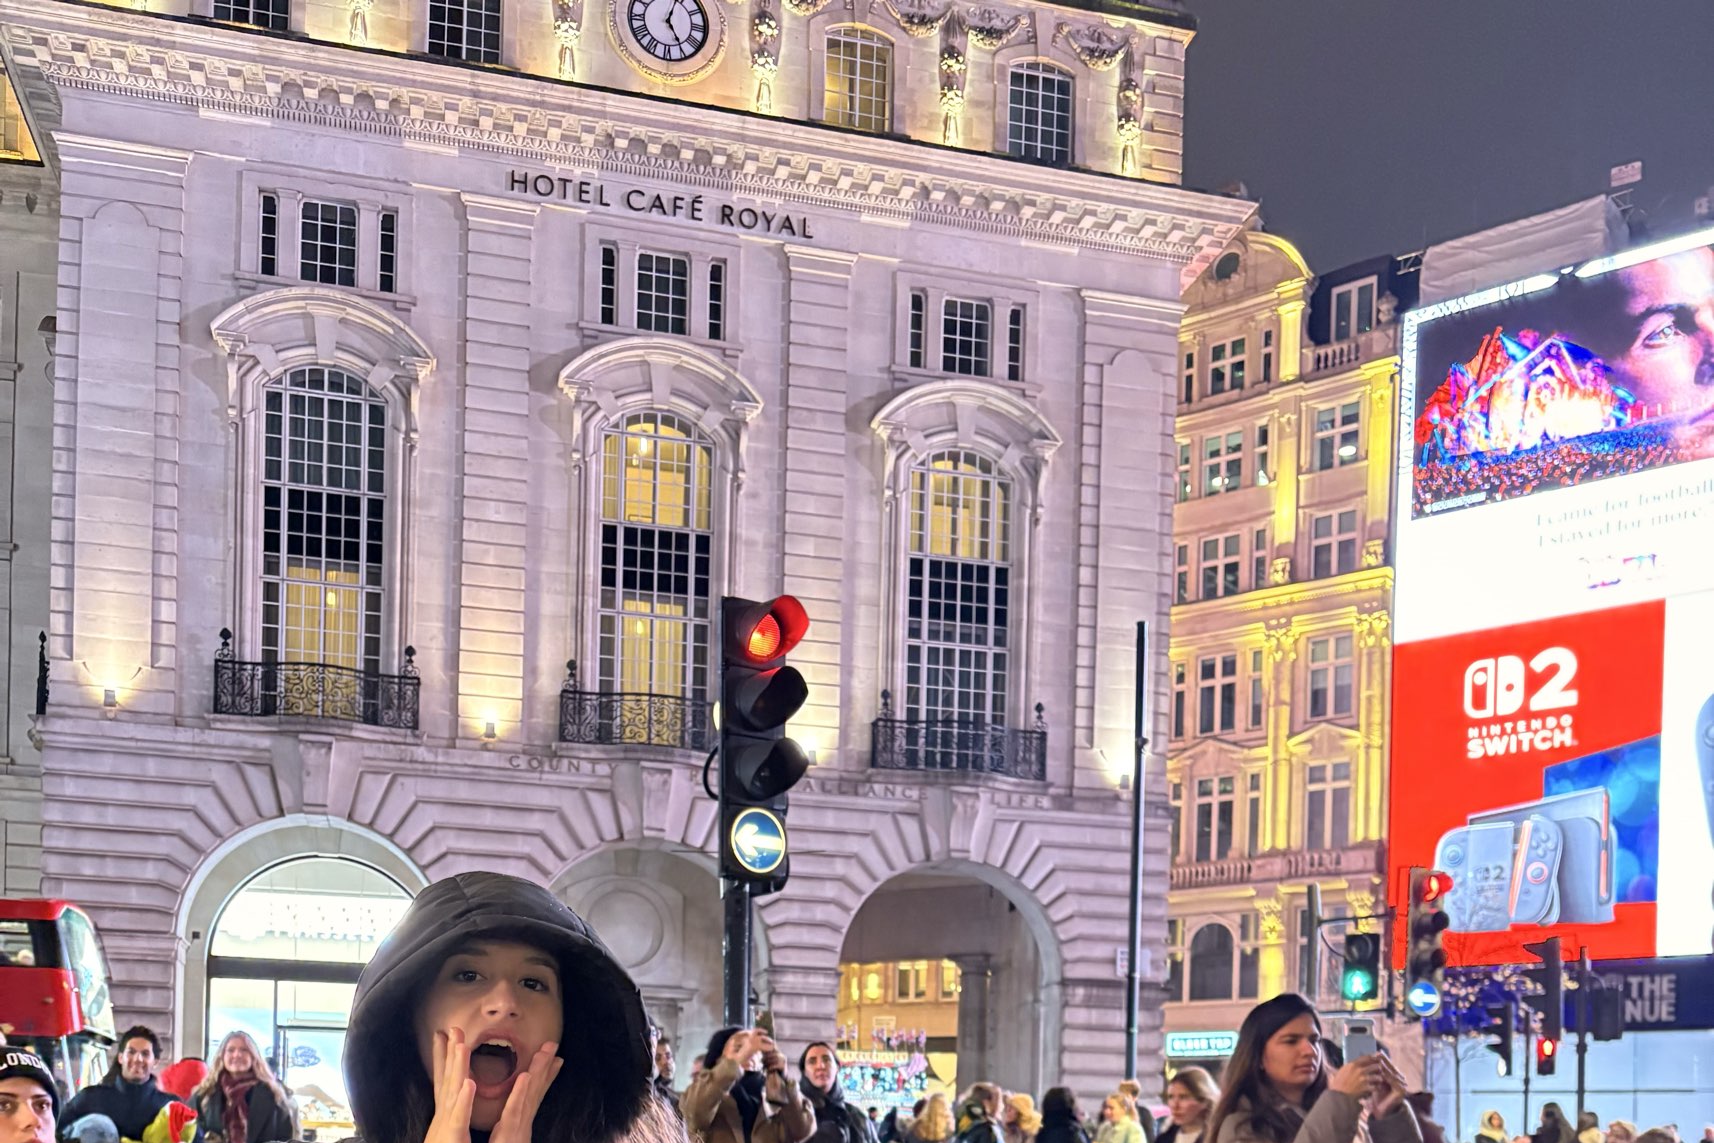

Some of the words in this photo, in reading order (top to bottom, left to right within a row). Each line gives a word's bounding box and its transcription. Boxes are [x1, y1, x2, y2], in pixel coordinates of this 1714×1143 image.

[510, 170, 610, 207] HOTEL
[626, 190, 703, 221] CAFÉ
[721, 204, 813, 239] ROYAL
[1529, 646, 1578, 711] 2
[1468, 714, 1573, 738] NINTENDO
[1467, 727, 1572, 759] SWITCH
[508, 755, 617, 776] COUNTY
[803, 780, 928, 799] ALLIANCE
[1627, 974, 1676, 998] THE
[1625, 998, 1676, 1022] NUE
